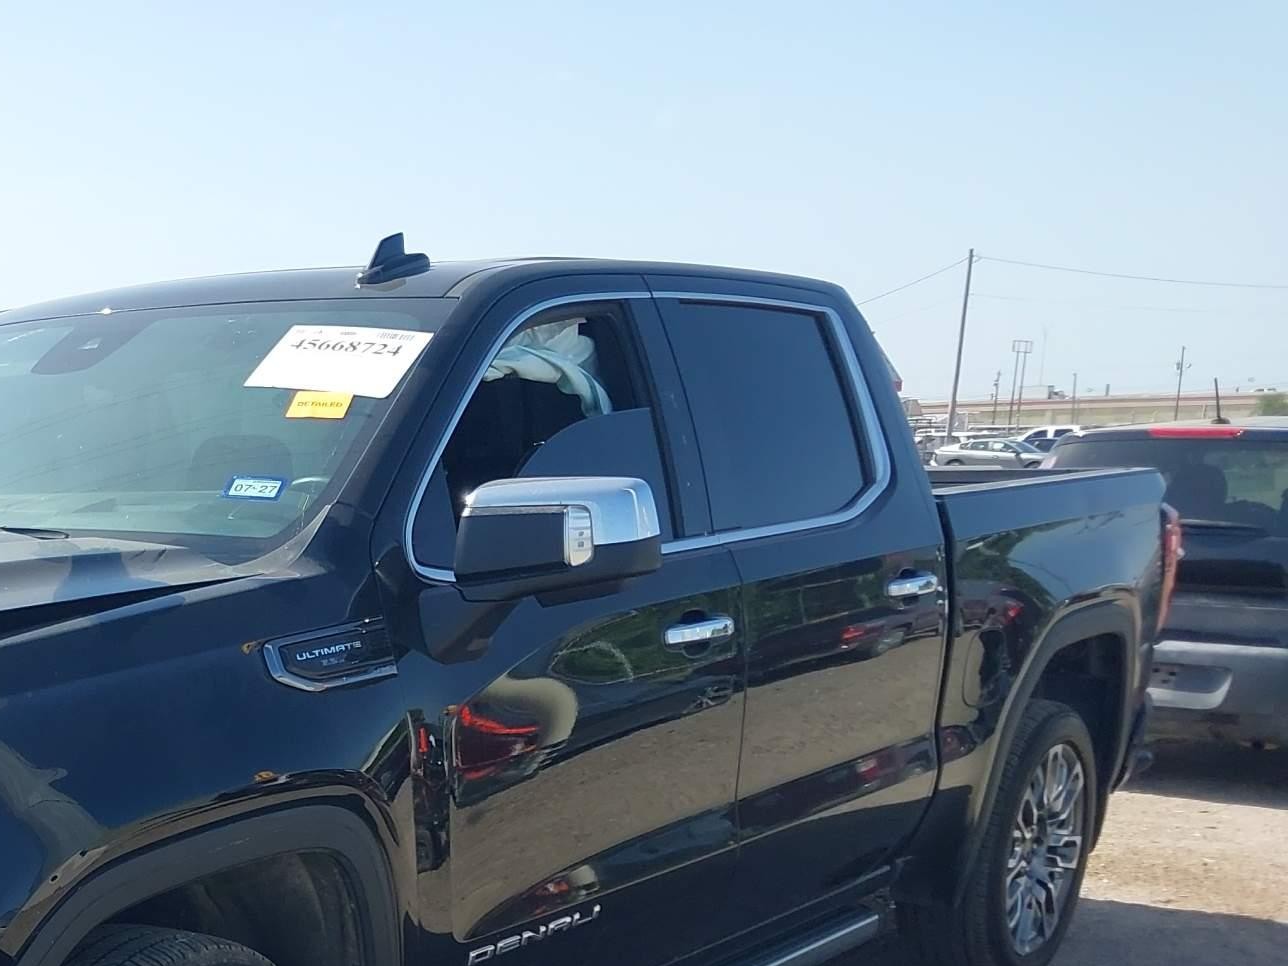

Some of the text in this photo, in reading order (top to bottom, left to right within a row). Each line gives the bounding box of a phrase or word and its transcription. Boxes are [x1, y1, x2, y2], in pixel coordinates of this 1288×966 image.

[290, 338, 403, 356] 45668724
[296, 640, 362, 661] ULTIMATE
[467, 903, 602, 966] DENALI
